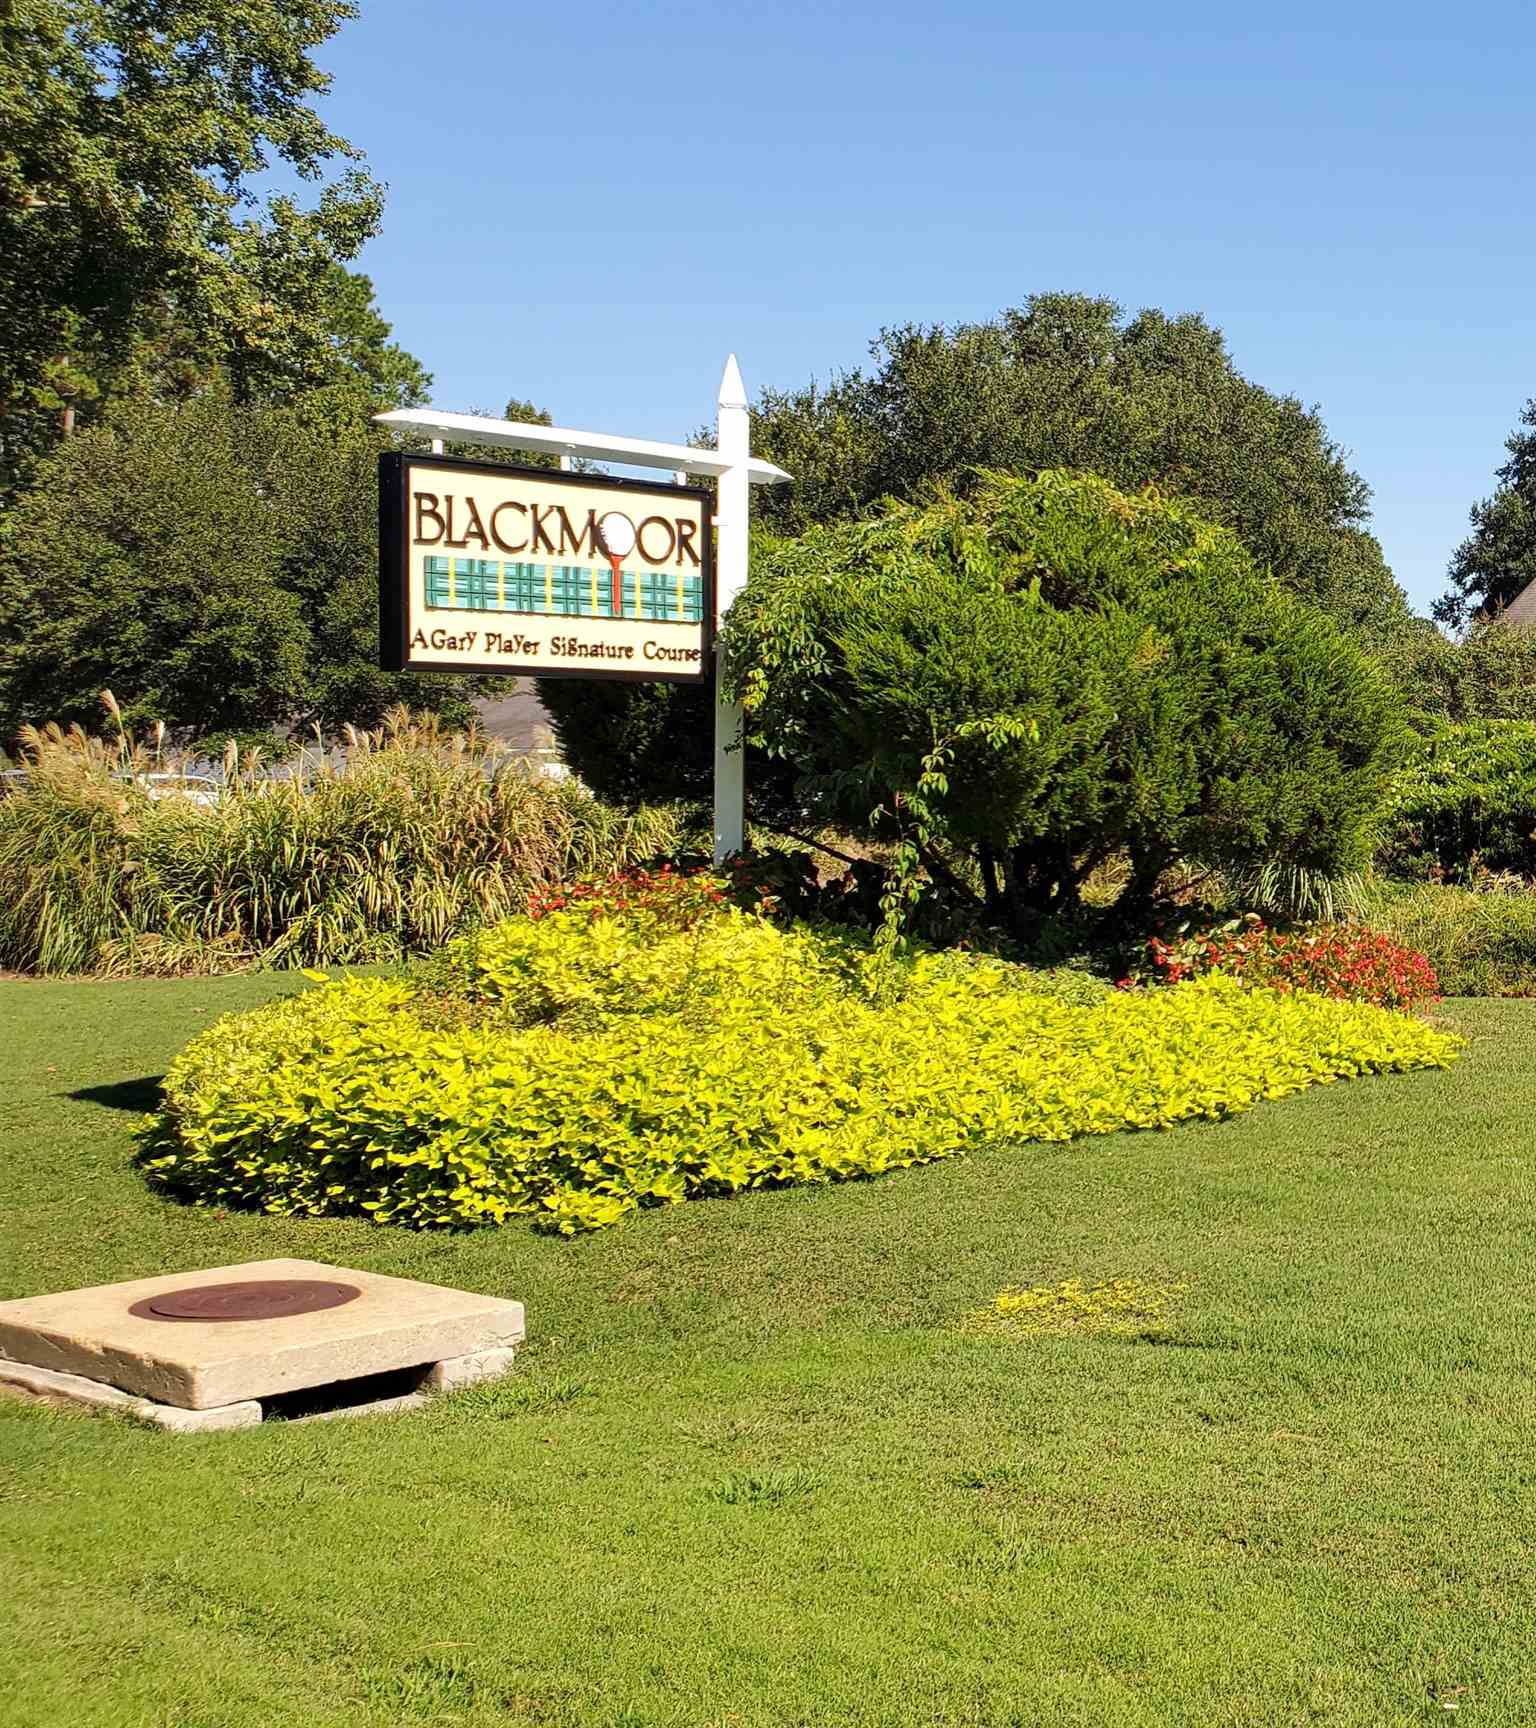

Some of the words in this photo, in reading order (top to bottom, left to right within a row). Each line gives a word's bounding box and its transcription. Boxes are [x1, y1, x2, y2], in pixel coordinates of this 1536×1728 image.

[413, 491, 702, 567] BLACKMOOR
[409, 627, 429, 649] A
[550, 636, 634, 660] Signature
[643, 640, 702, 662] Course
